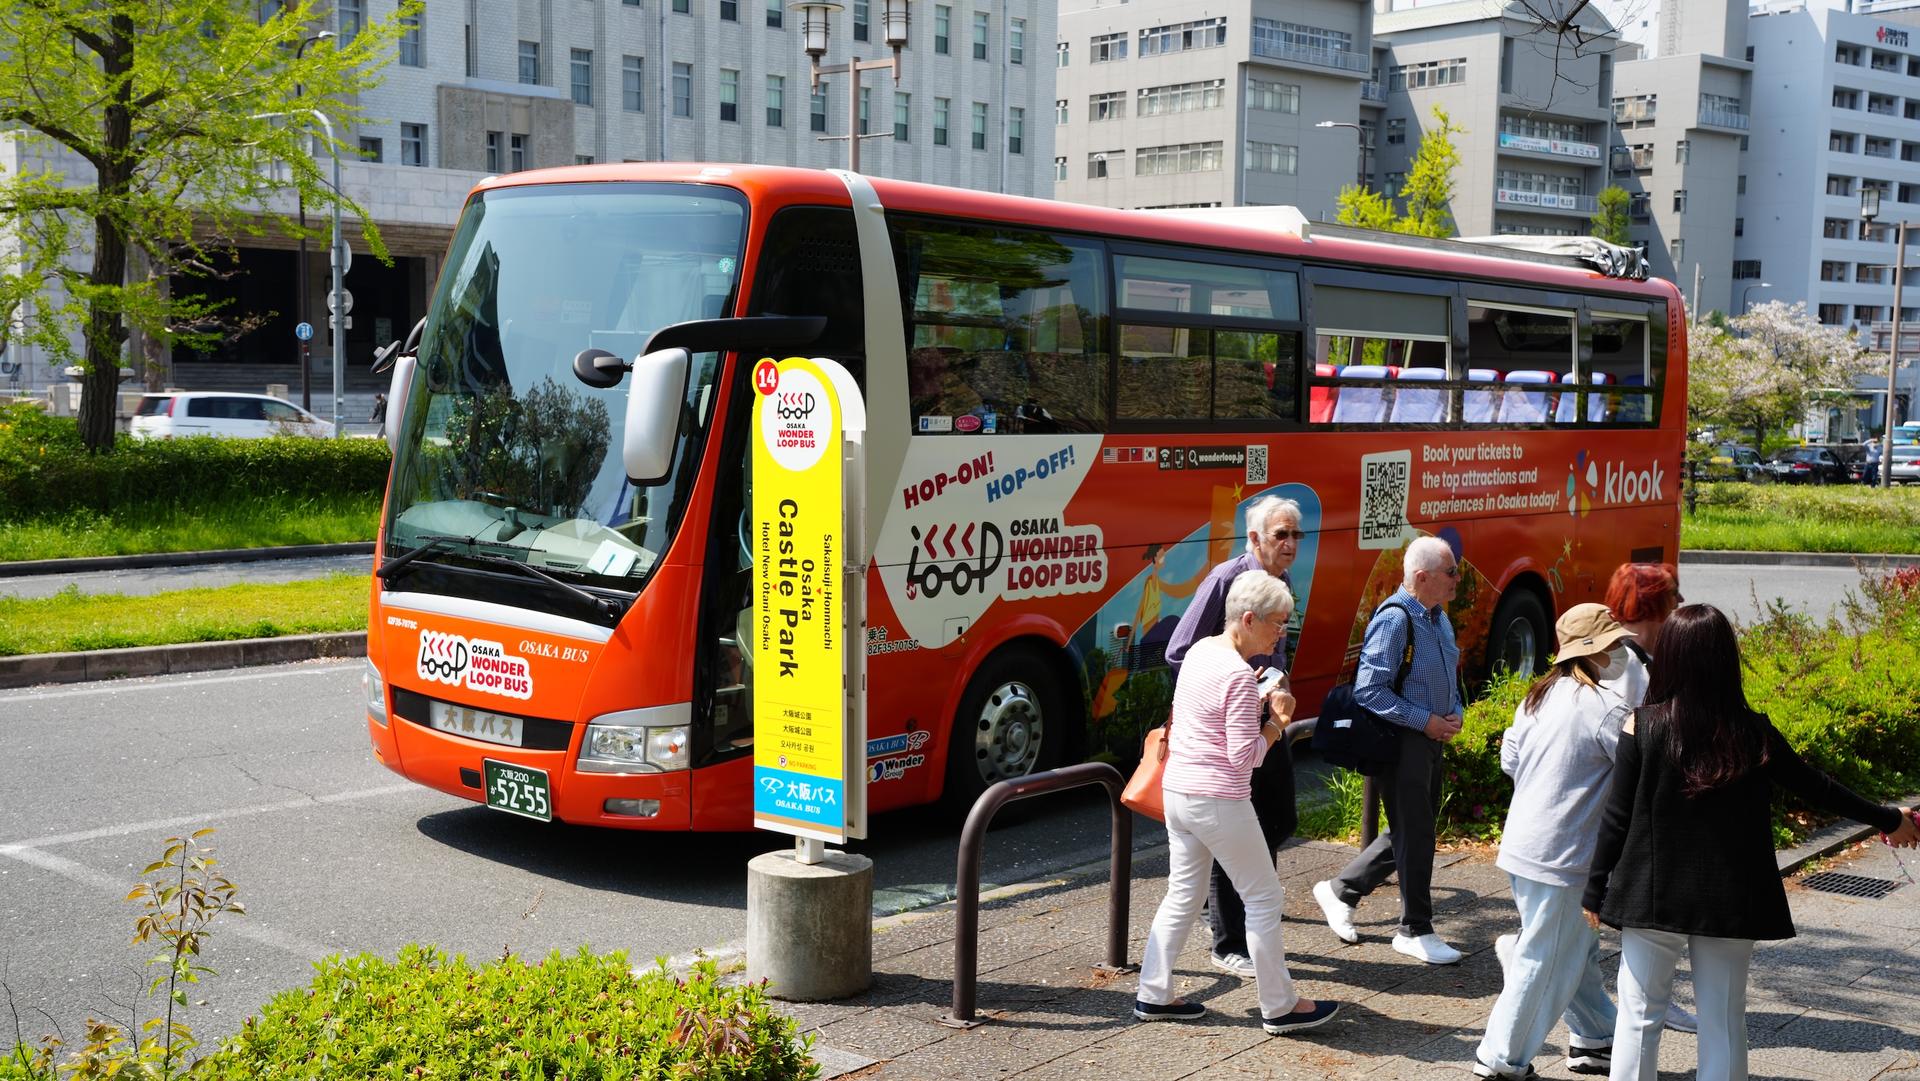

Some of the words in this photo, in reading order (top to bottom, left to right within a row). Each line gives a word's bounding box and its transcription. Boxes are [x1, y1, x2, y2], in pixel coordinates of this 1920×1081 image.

[758, 367, 777, 388] 14
[777, 439, 799, 448] LOOP
[800, 440, 816, 449] BUS
[778, 429, 814, 439] WONDER
[1199, 451, 1244, 464] wonderloop.jp
[1423, 443, 1450, 462] Book
[1452, 445, 1476, 467] your
[1477, 442, 1511, 460] tickets
[1513, 443, 1523, 459] to
[903, 451, 995, 510] HOP-ON!
[986, 445, 1076, 504] HOP-OFF!
[1422, 470, 1440, 489] the
[1442, 471, 1460, 493] top
[1461, 467, 1517, 487] attractions
[1518, 466, 1538, 484] and
[1604, 459, 1664, 504] klook
[1420, 494, 1484, 520] experiences
[1486, 492, 1495, 511] in
[1497, 492, 1530, 510] Osaka
[1529, 490, 1560, 512] today!
[762, 521, 770, 552] Hotel
[1010, 518, 1059, 536] OSAKA
[778, 498, 799, 597] Castle
[1009, 534, 1098, 563] WONDER
[762, 555, 770, 580] New
[1007, 564, 1062, 591] LOOP
[1065, 560, 1103, 585] BUS
[762, 581, 771, 612] Otani
[801, 559, 815, 621] Osaka
[822, 533, 833, 650] Sakaisuji-Honmachi
[762, 615, 771, 650] Osaka
[779, 609, 799, 678] Park
[867, 628, 887, 642] 乗合
[472, 644, 500, 658] OSAKA
[519, 640, 560, 657] OSAKA
[562, 647, 590, 663] BUS
[471, 655, 525, 677] WONDER
[470, 670, 502, 687] LOOP
[504, 677, 529, 694] BUS
[443, 705, 514, 741] 大阪バス
[780, 740, 802, 752] 오사카성
[803, 743, 815, 753] 공원
[496, 778, 548, 815] 52-55
[786, 780, 837, 805] 大阪バス
[775, 799, 803, 811] OSAKA
[804, 804, 821, 815] BUS
